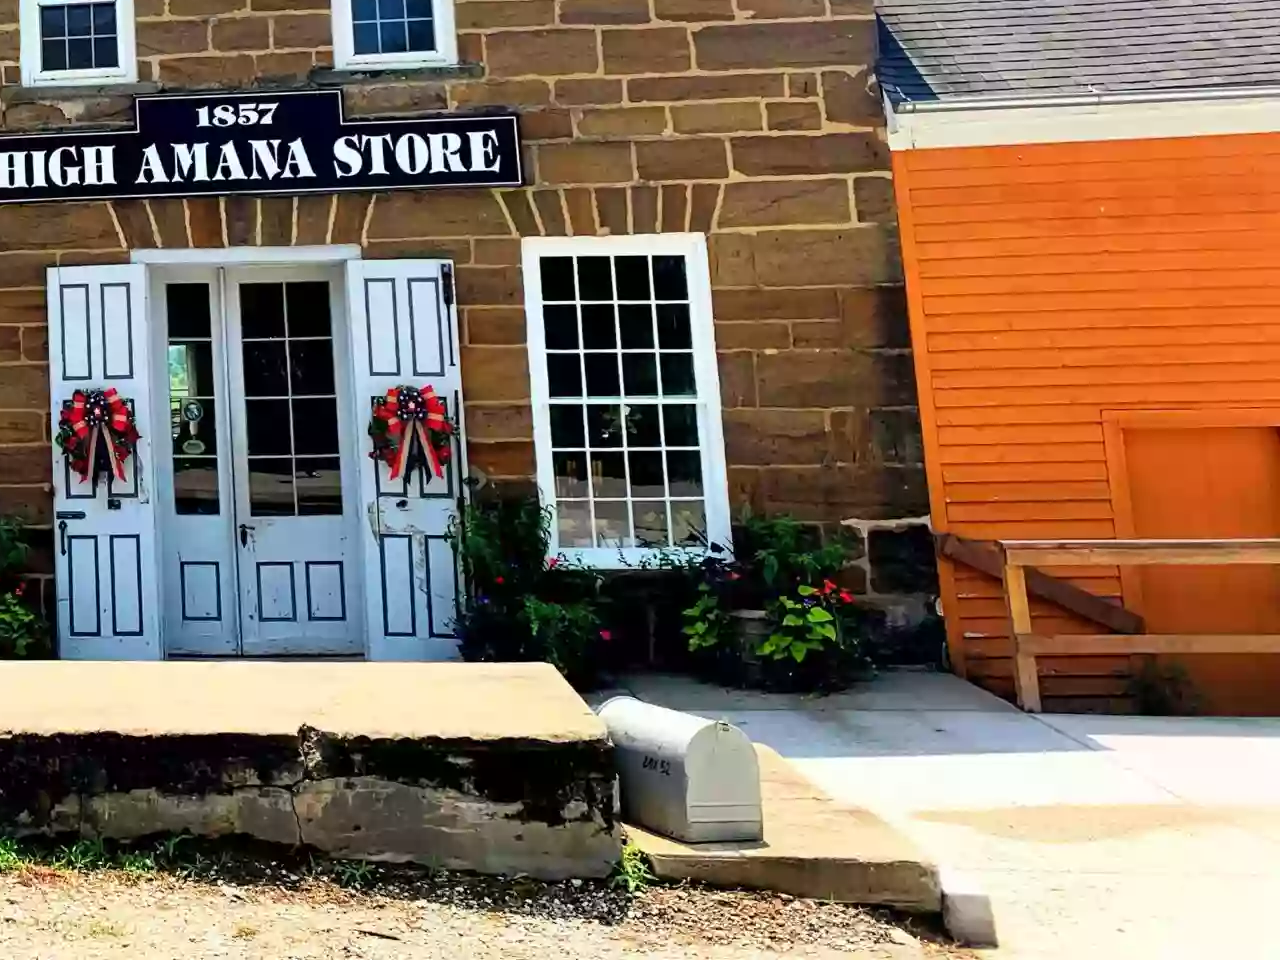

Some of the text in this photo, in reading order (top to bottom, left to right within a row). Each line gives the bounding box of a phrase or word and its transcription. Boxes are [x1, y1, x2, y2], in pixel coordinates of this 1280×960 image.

[195, 102, 279, 128] 1857
[134, 137, 317, 184] AMANA
[332, 129, 501, 178] STORE
